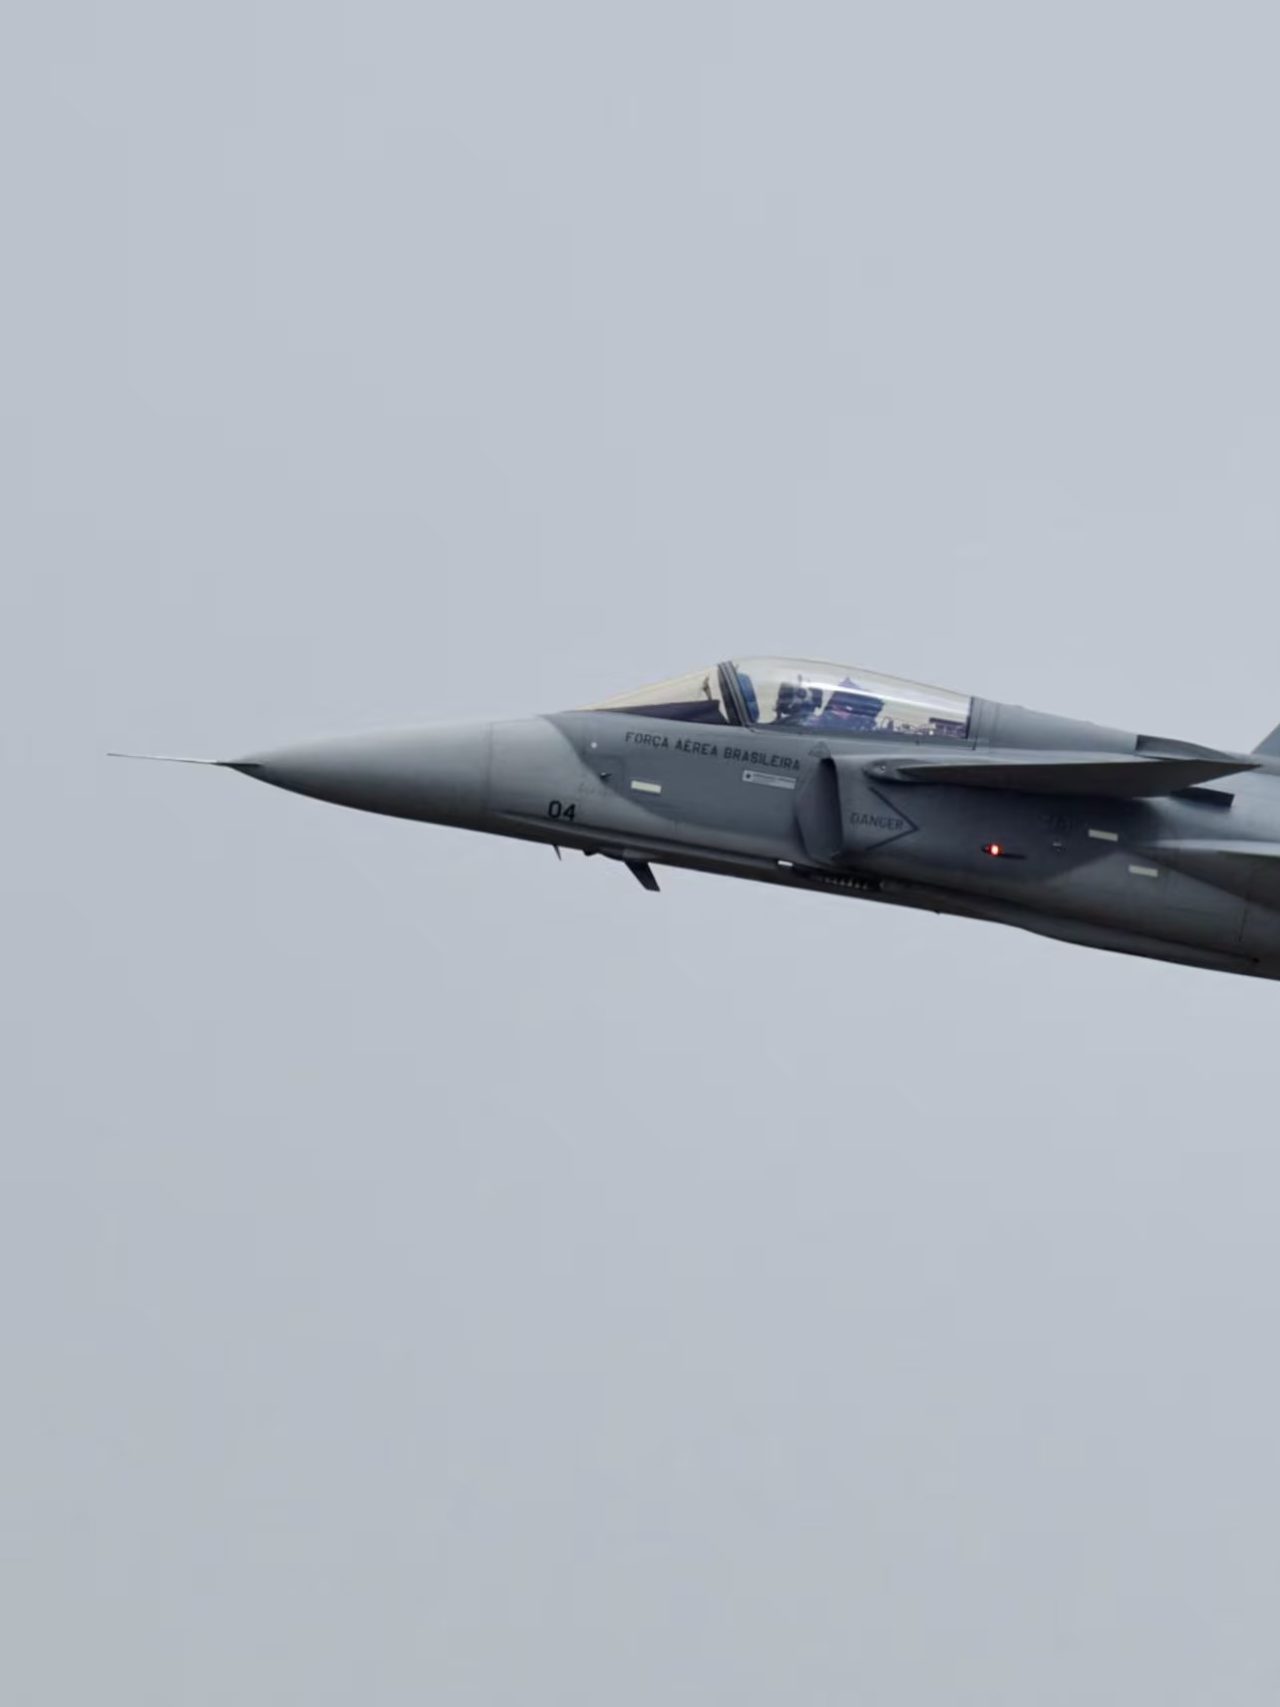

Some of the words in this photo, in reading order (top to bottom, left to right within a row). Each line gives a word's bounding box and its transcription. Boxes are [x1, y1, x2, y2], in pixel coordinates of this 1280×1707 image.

[625, 731, 669, 749] FORÇA
[674, 737, 718, 756] AÉREA
[723, 746, 800, 771] BRASILEIRA
[548, 800, 576, 821] 04
